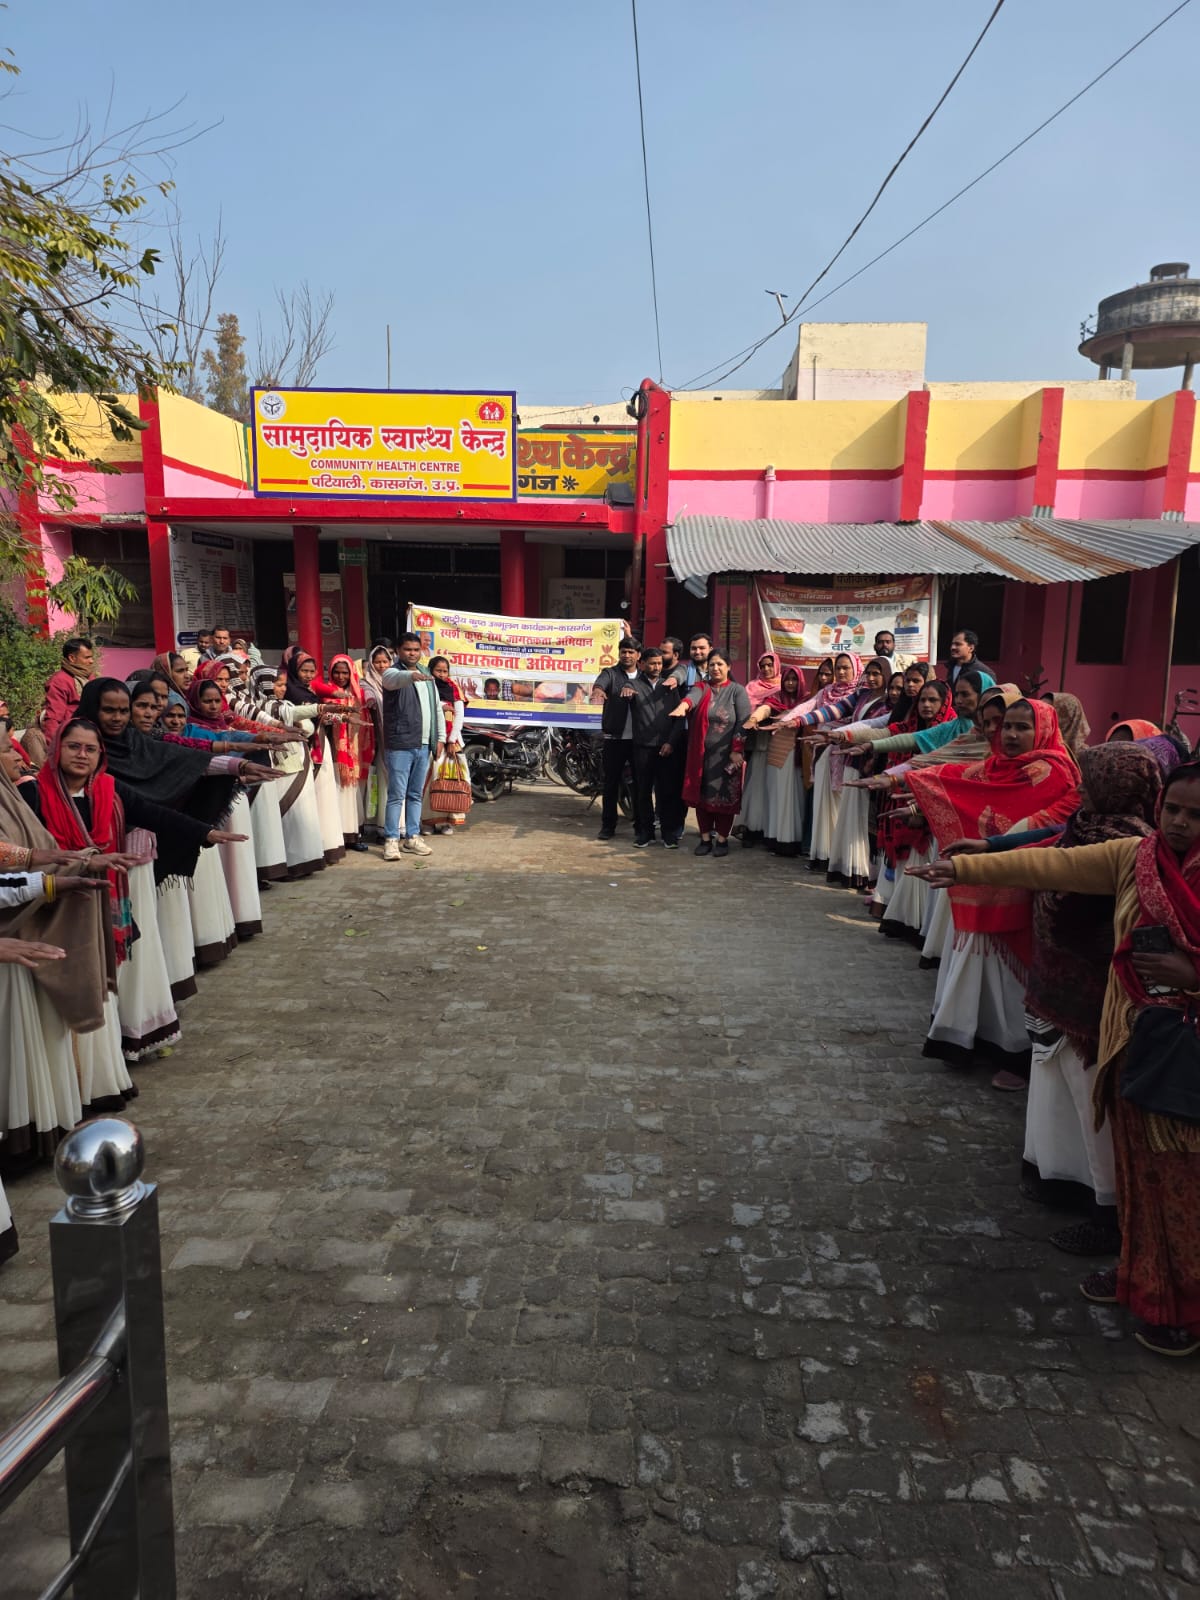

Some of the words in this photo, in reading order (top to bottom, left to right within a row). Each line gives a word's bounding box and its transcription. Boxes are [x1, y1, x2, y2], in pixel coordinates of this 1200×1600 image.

[262, 418, 373, 457] सामुदायिक
[381, 426, 453, 450] स्वास्थ्य
[461, 421, 506, 457] केन्द्र
[563, 433, 634, 477] केन्द्र
[310, 459, 373, 470] COMMUNITY
[376, 461, 416, 471] HEALTH
[419, 462, 460, 472] CENTRE
[311, 474, 366, 489] पटियाली,
[369, 476, 428, 490] कासगंज,
[432, 480, 460, 492] उ.प्र.
[853, 585, 906, 598] दस्तक
[556, 635, 593, 647] अभियान
[834, 628, 842, 643] 7
